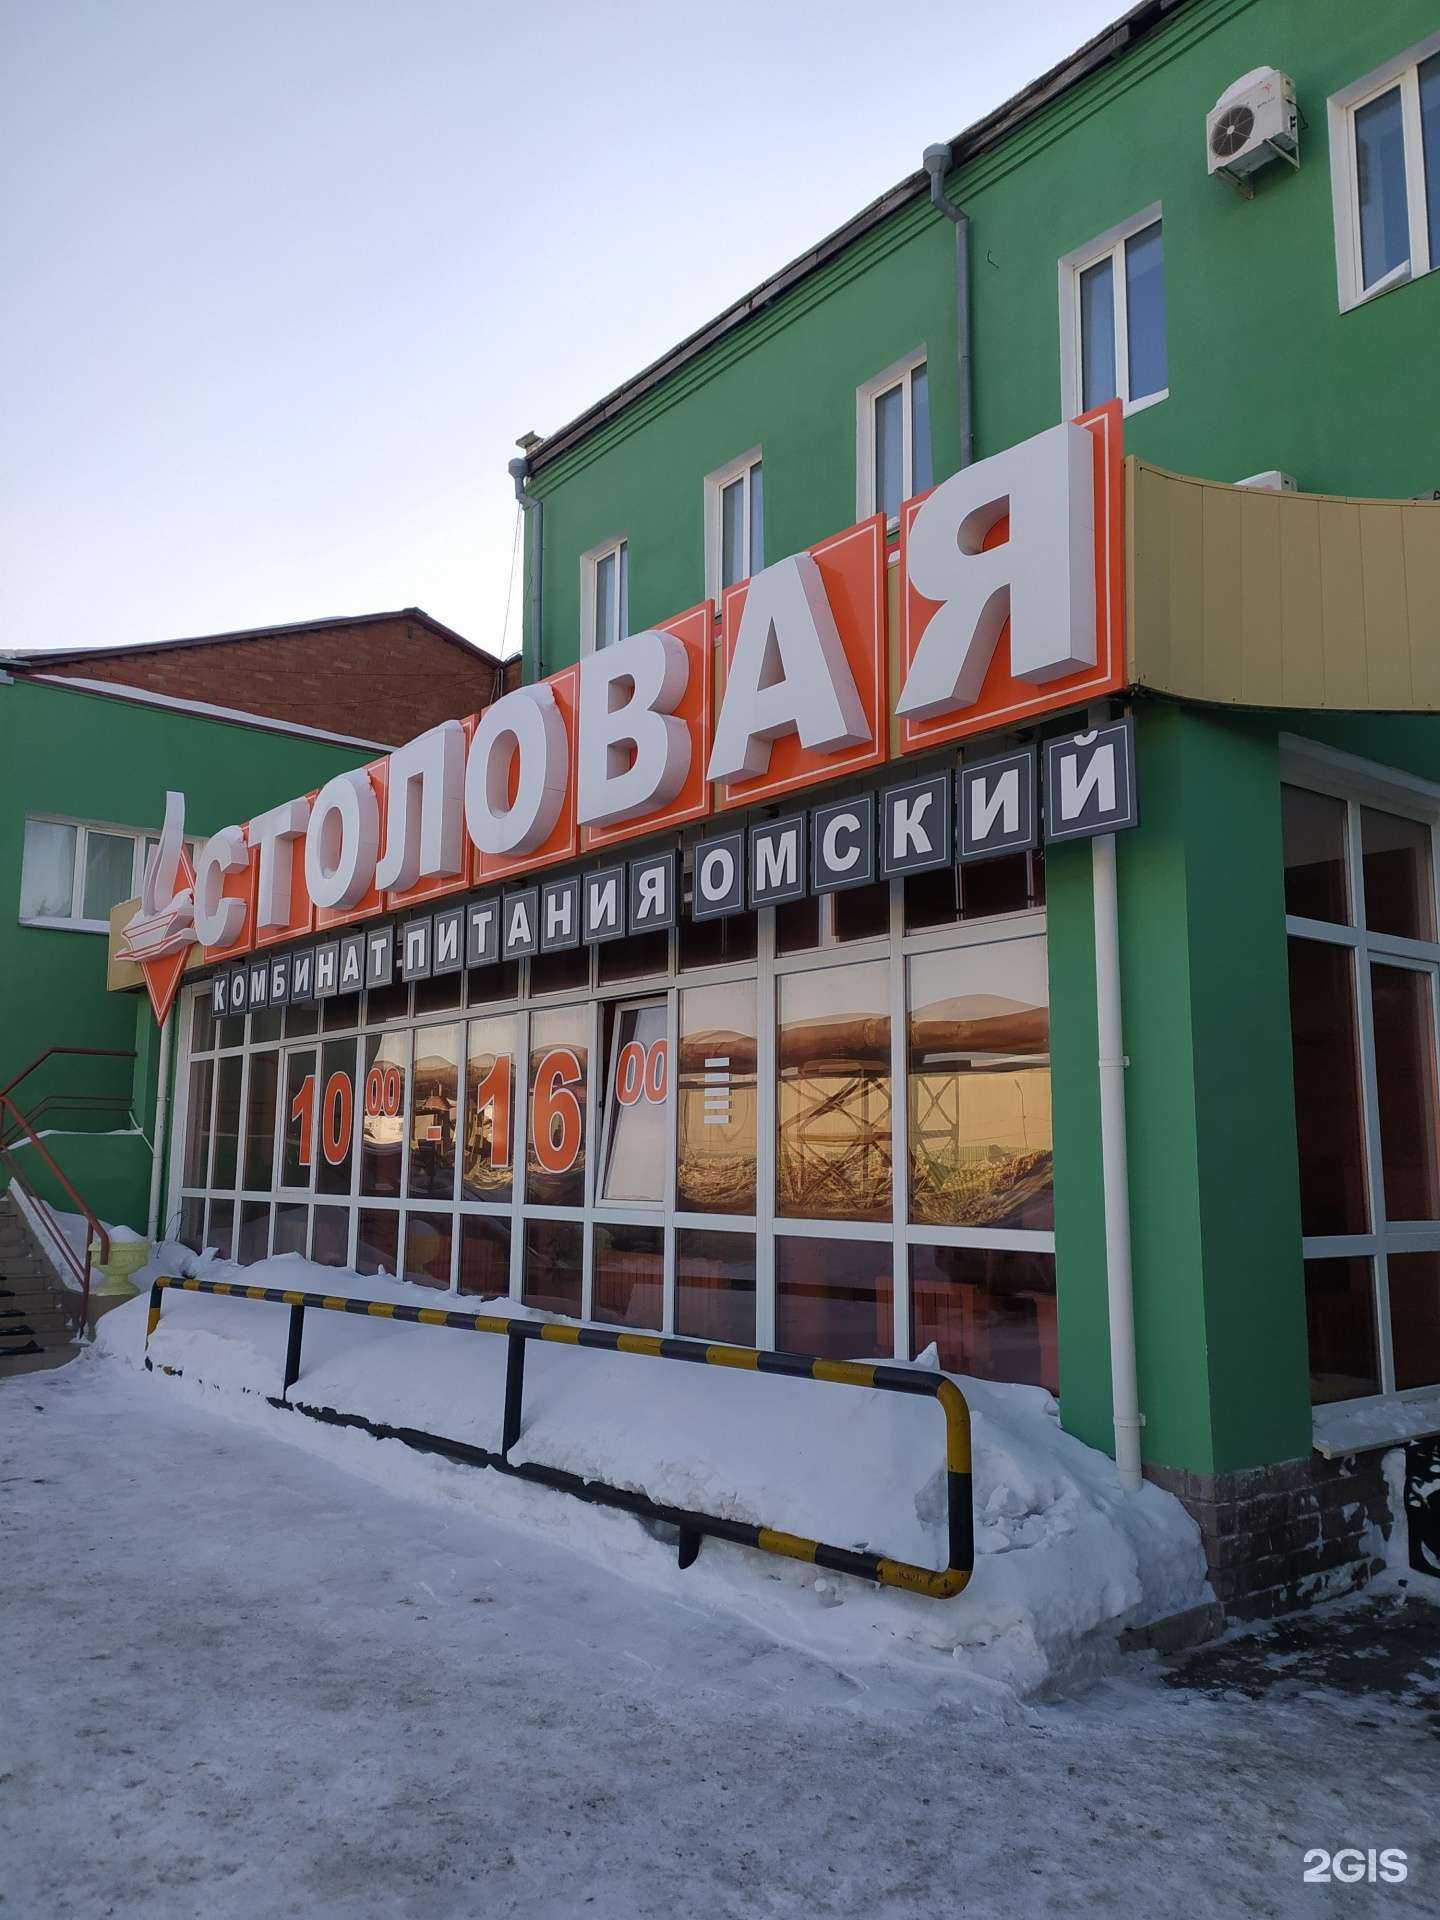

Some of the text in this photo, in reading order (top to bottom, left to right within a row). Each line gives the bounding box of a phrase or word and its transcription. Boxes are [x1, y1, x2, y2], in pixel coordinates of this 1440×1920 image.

[194, 421, 1097, 947] СТОЛОВАЯ
[214, 729, 1116, 1011] КОМБИНАТ ПИТАНИЯ ОМСКИЙ
[477, 1048, 582, 1174] 16
